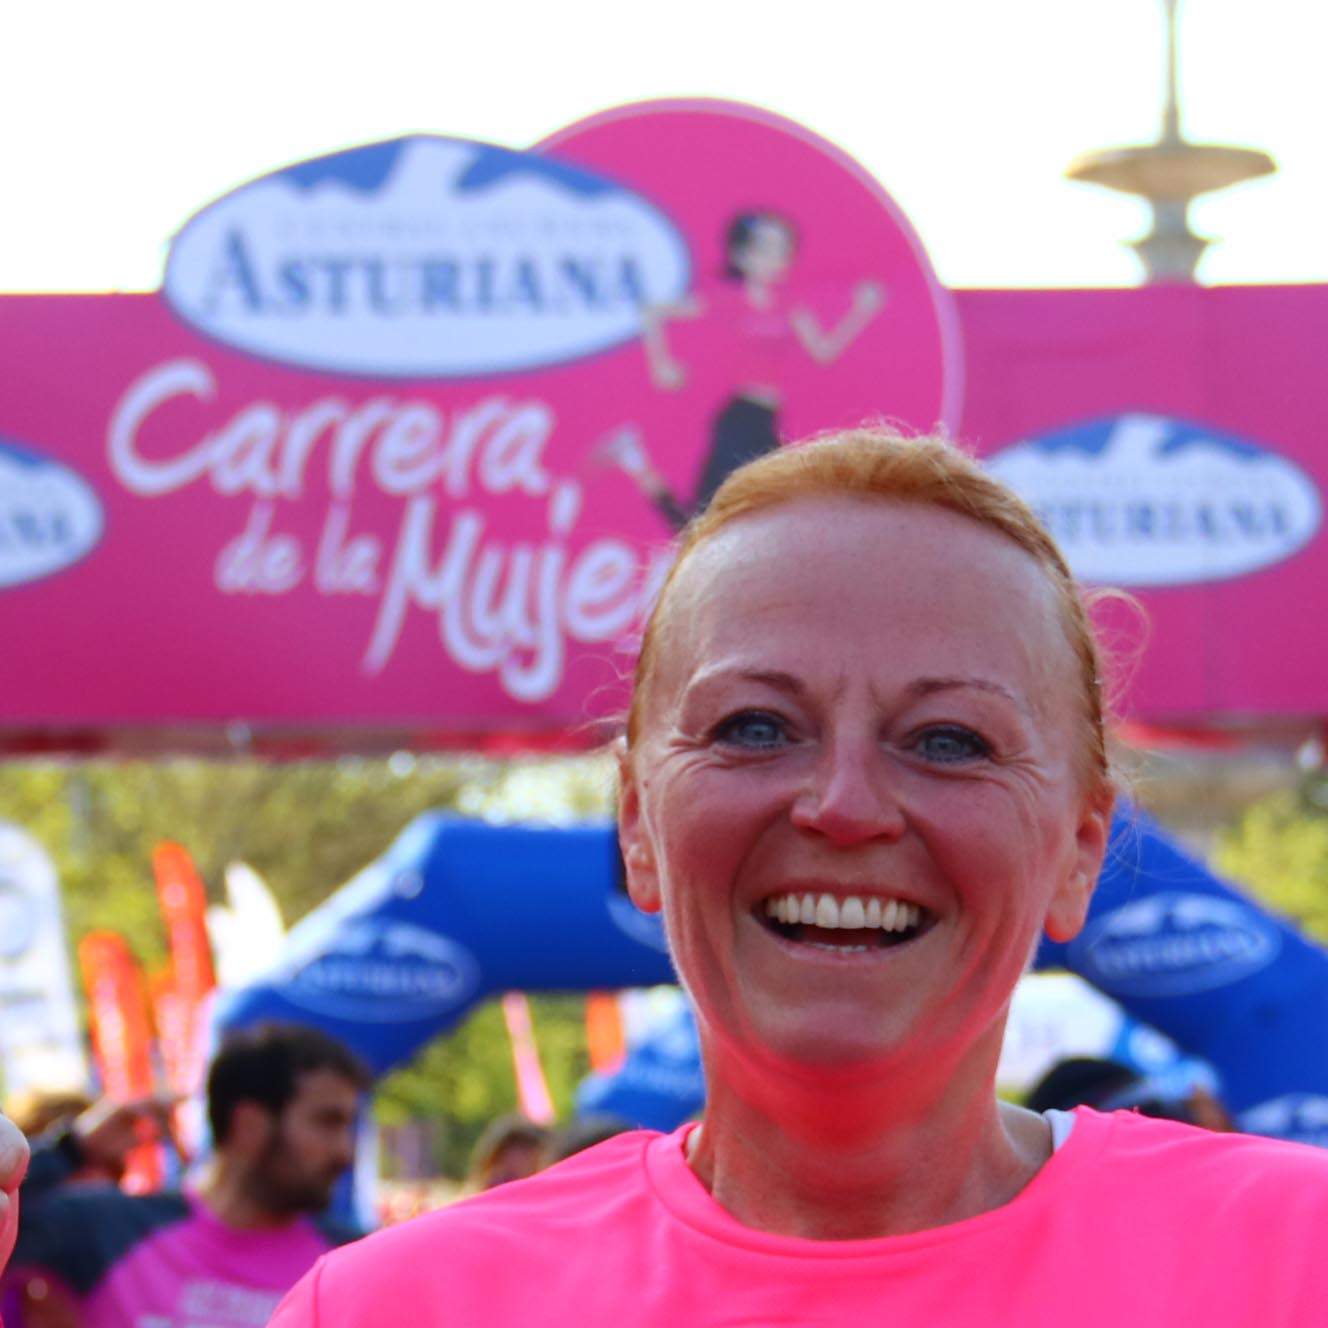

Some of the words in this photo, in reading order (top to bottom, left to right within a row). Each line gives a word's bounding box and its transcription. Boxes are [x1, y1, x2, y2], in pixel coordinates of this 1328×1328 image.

[202, 228, 645, 315] ASTURIANA
[106, 359, 552, 496] Carrera
[215, 498, 304, 594] de
[313, 501, 381, 594] la
